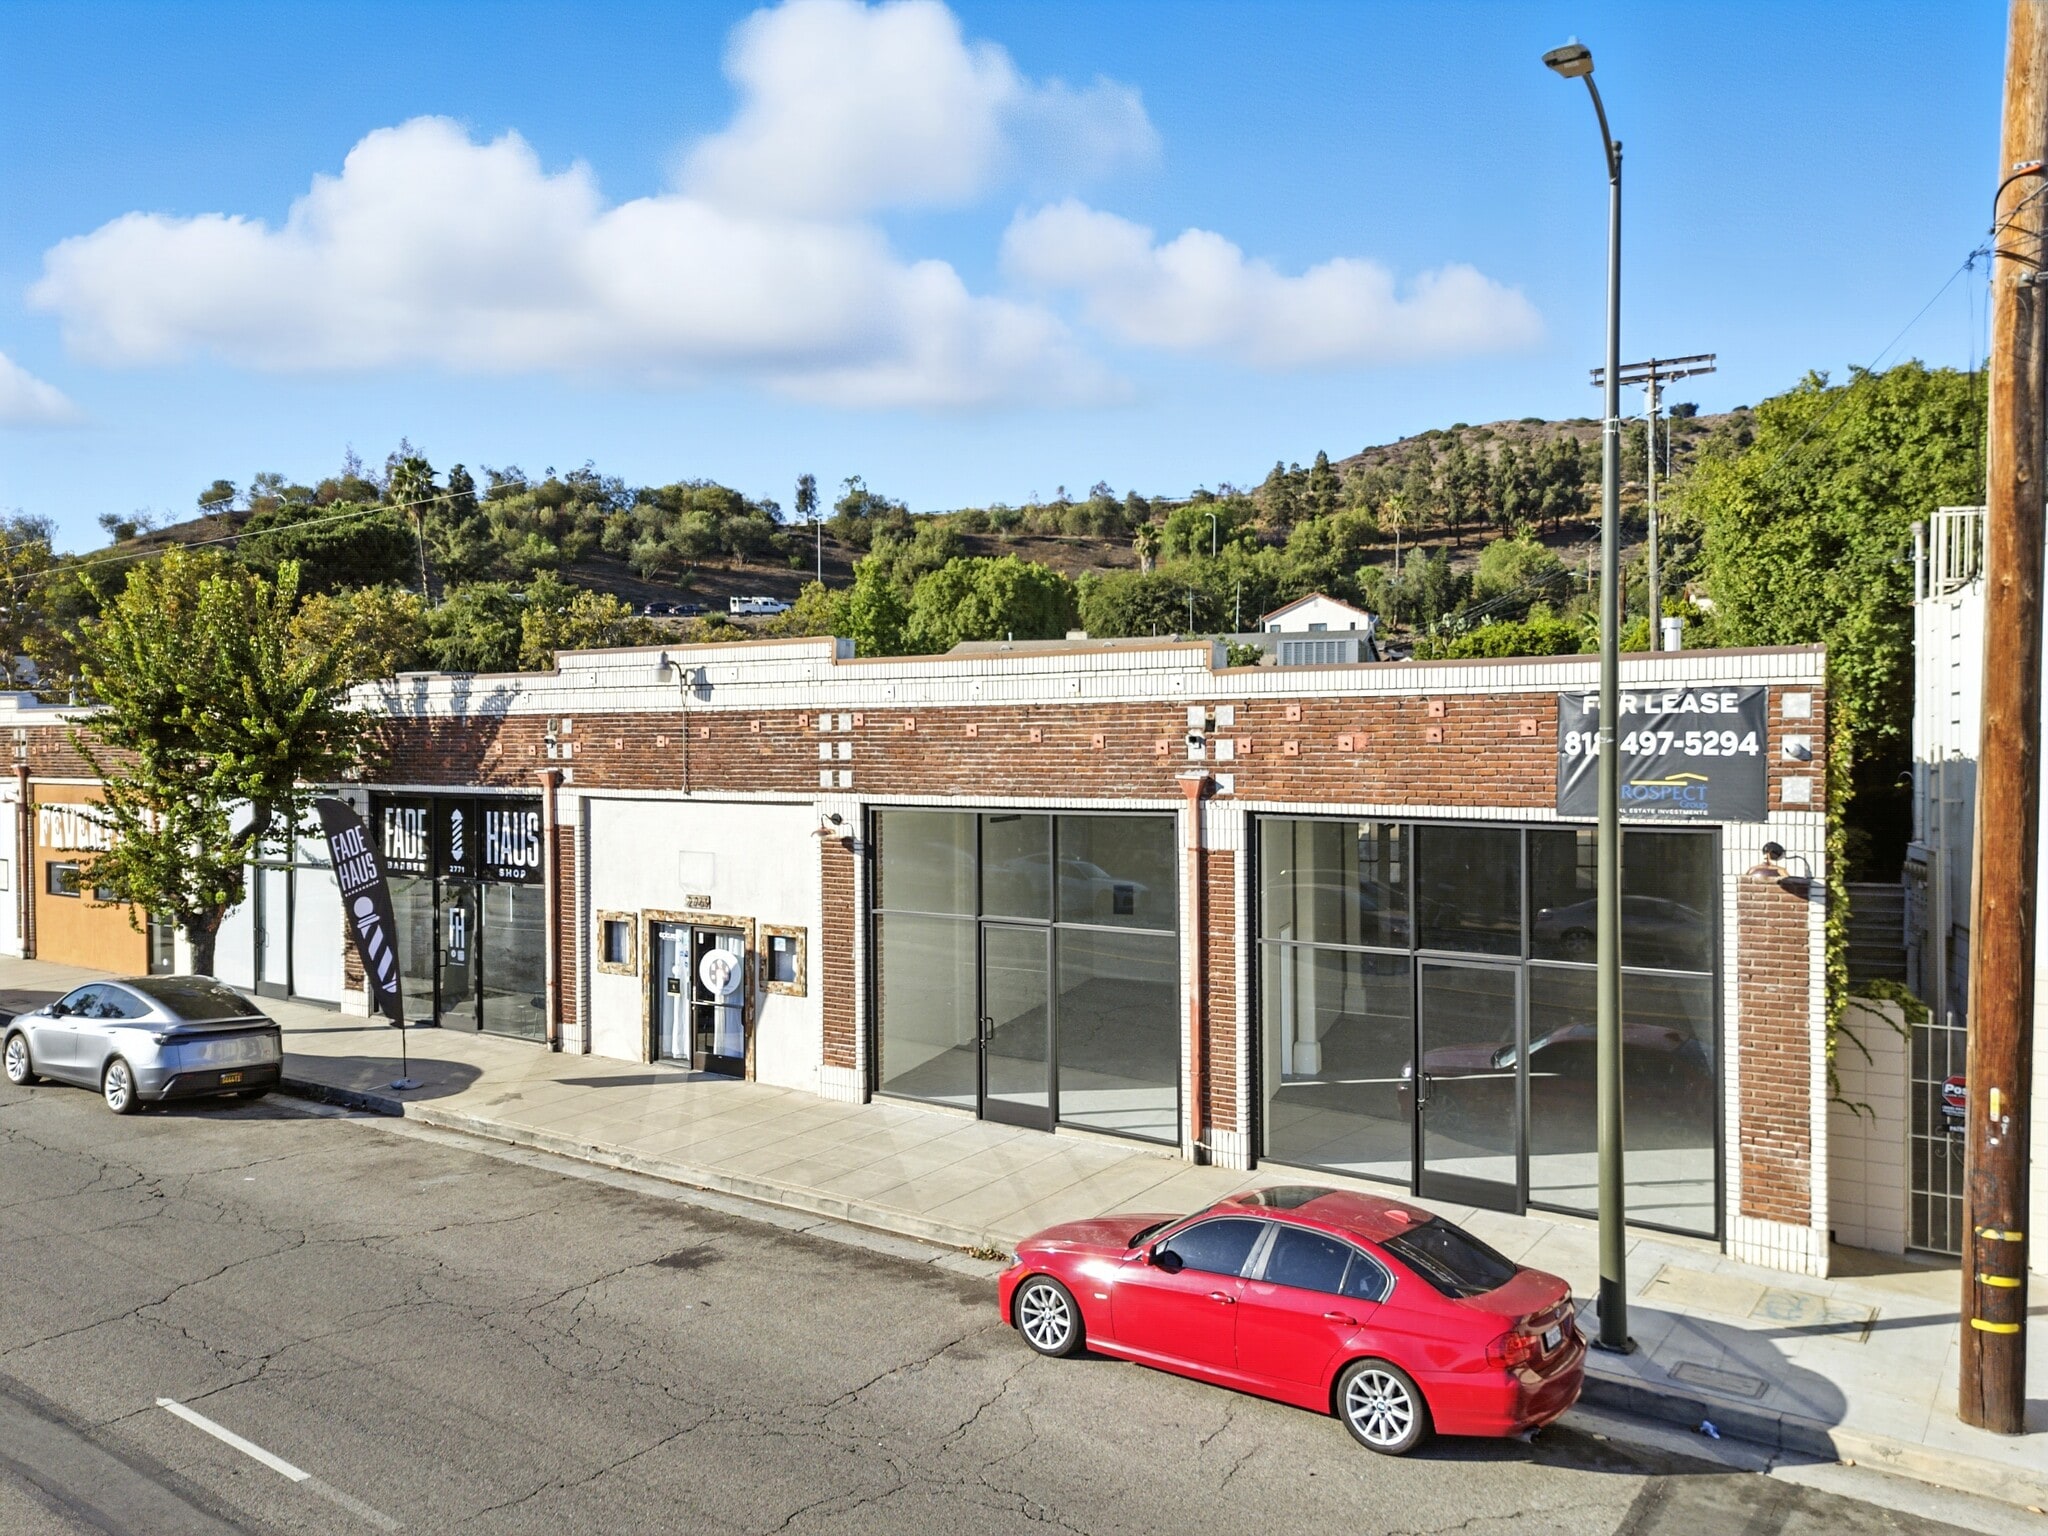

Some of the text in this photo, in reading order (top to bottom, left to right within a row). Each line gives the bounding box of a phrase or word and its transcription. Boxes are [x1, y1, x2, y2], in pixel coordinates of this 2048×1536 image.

[1582, 693, 1739, 715] FR LEASE
[1621, 785, 1708, 801] ROSPECT
[1680, 800, 1708, 809] Group
[331, 825, 367, 863] FADE
[385, 807, 427, 860] FADE
[486, 811, 539, 867] HAUS
[338, 852, 377, 891] HAUS
[449, 865, 465, 873] 2771
[499, 868, 526, 879] SHOP
